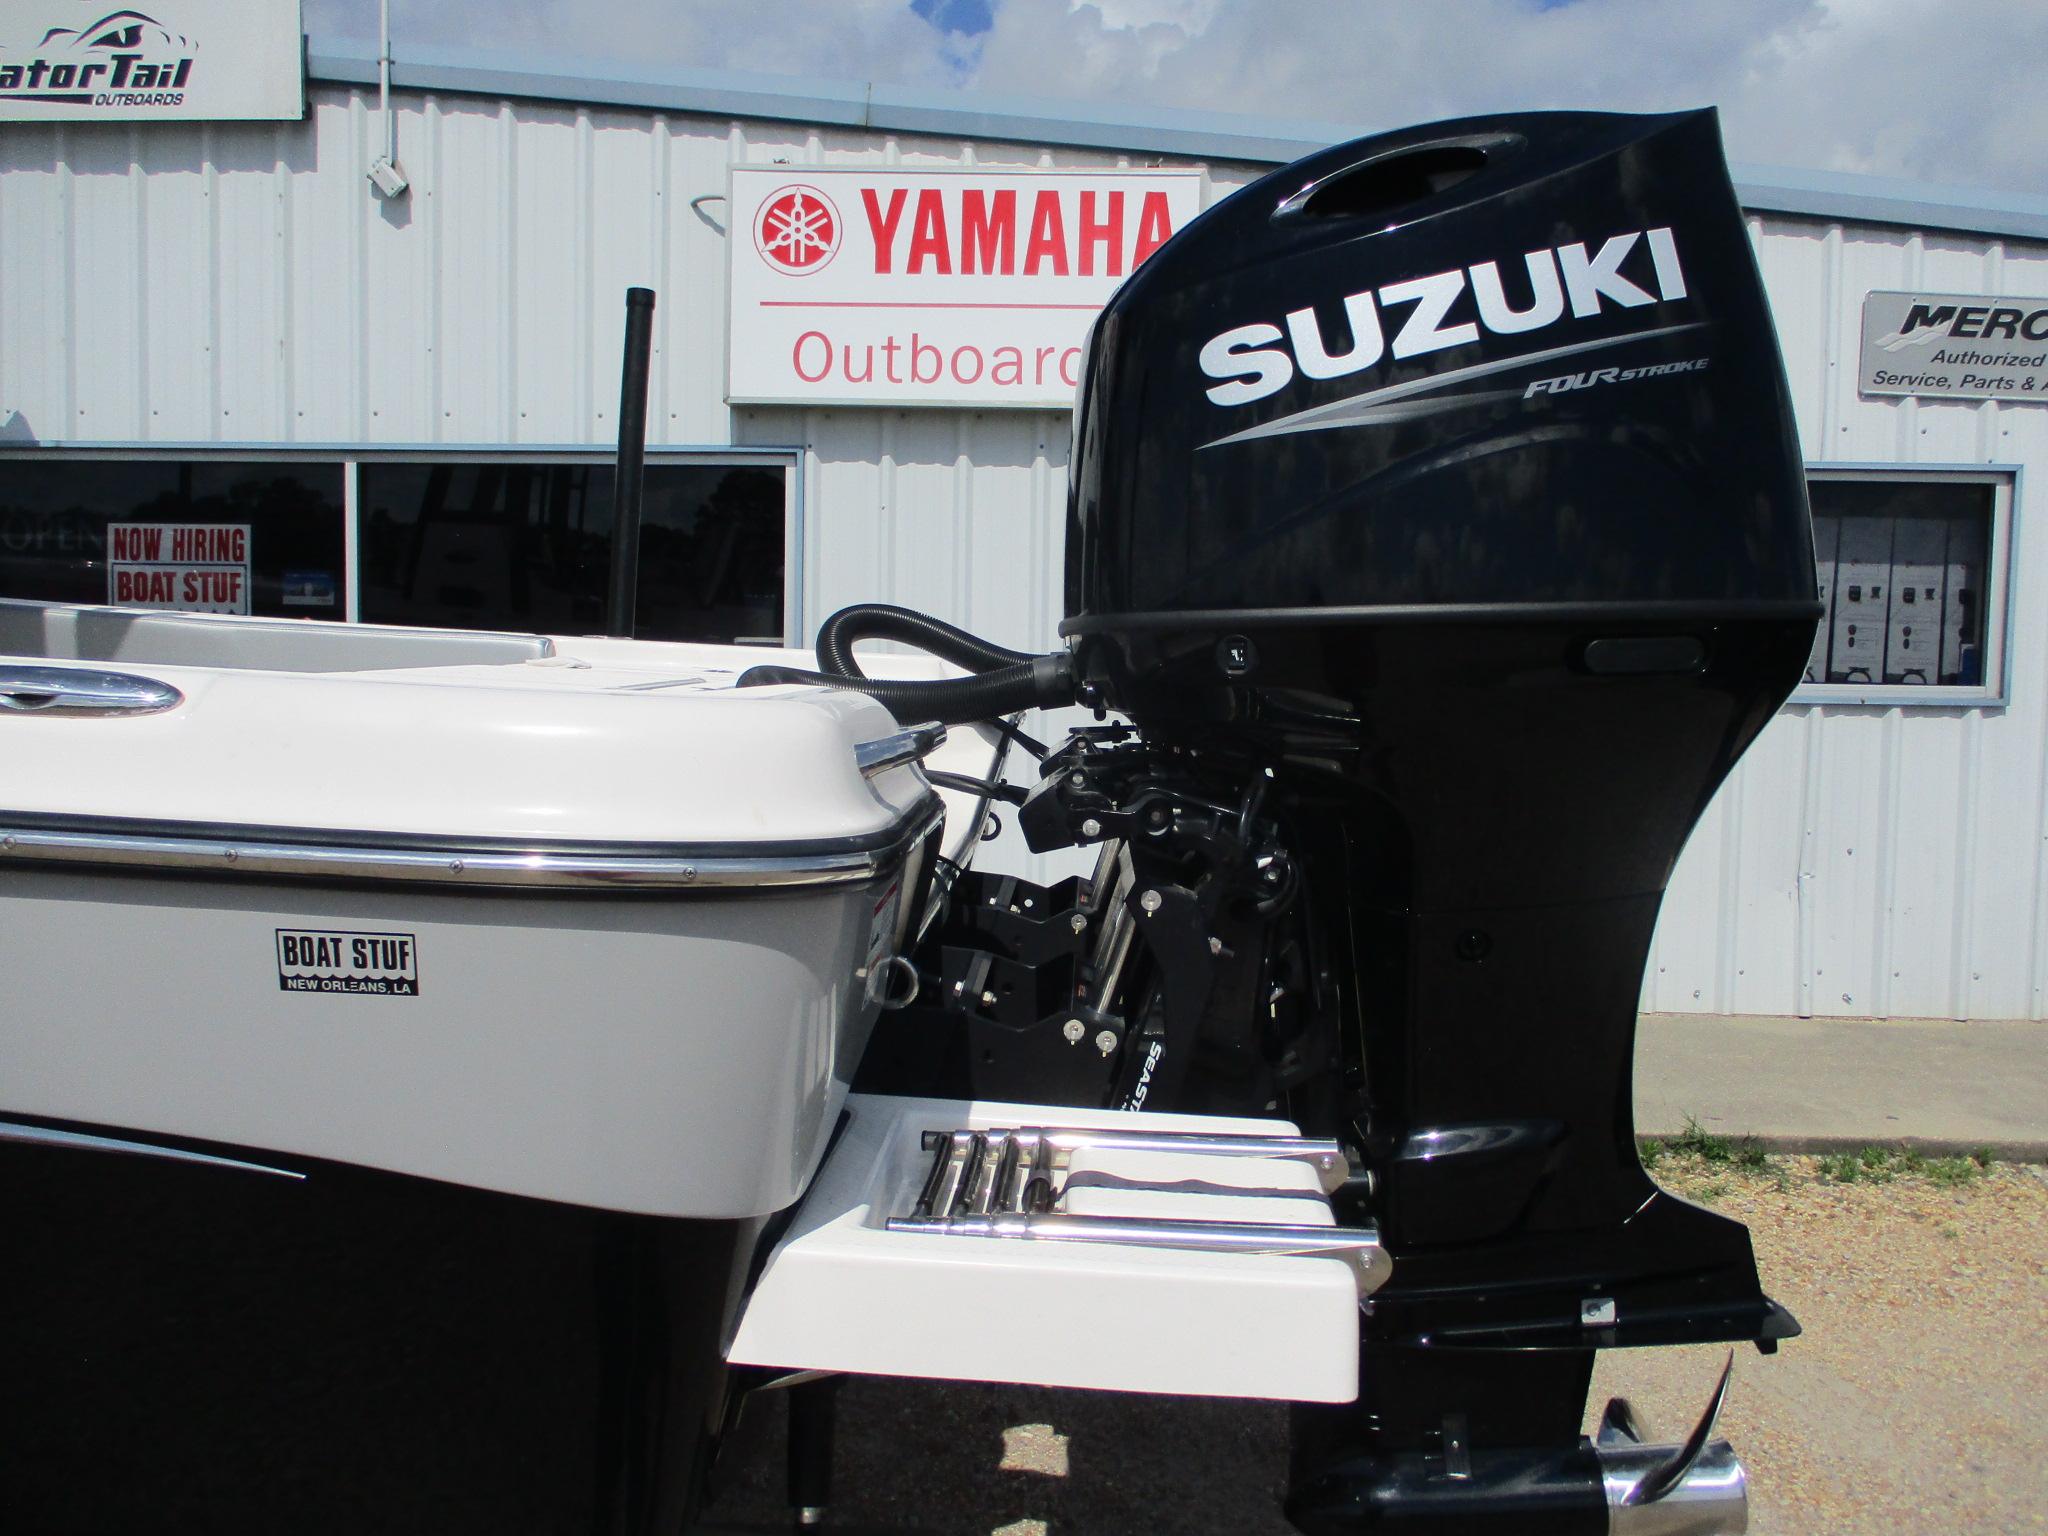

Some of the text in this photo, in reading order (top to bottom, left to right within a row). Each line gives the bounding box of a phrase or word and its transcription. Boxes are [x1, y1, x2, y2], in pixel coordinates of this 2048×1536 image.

[95, 93, 184, 106] OUTBOARDS
[860, 188, 1174, 277] YAMAHA
[1199, 227, 1687, 407] SUZUKI
[1931, 350, 2047, 368] Authorized
[1523, 358, 1710, 399] FOUR STROKE
[1873, 371, 1951, 389] Service,
[1960, 374, 2014, 390] Parts
[2021, 376, 2035, 391] &
[114, 527, 244, 562] NOW HIRING
[117, 571, 241, 603] BOAT STUF
[283, 936, 409, 970] BOAT STUF
[288, 979, 411, 994] NEW ORLEANS, LA
[1130, 1041, 1162, 1112] SEAST
